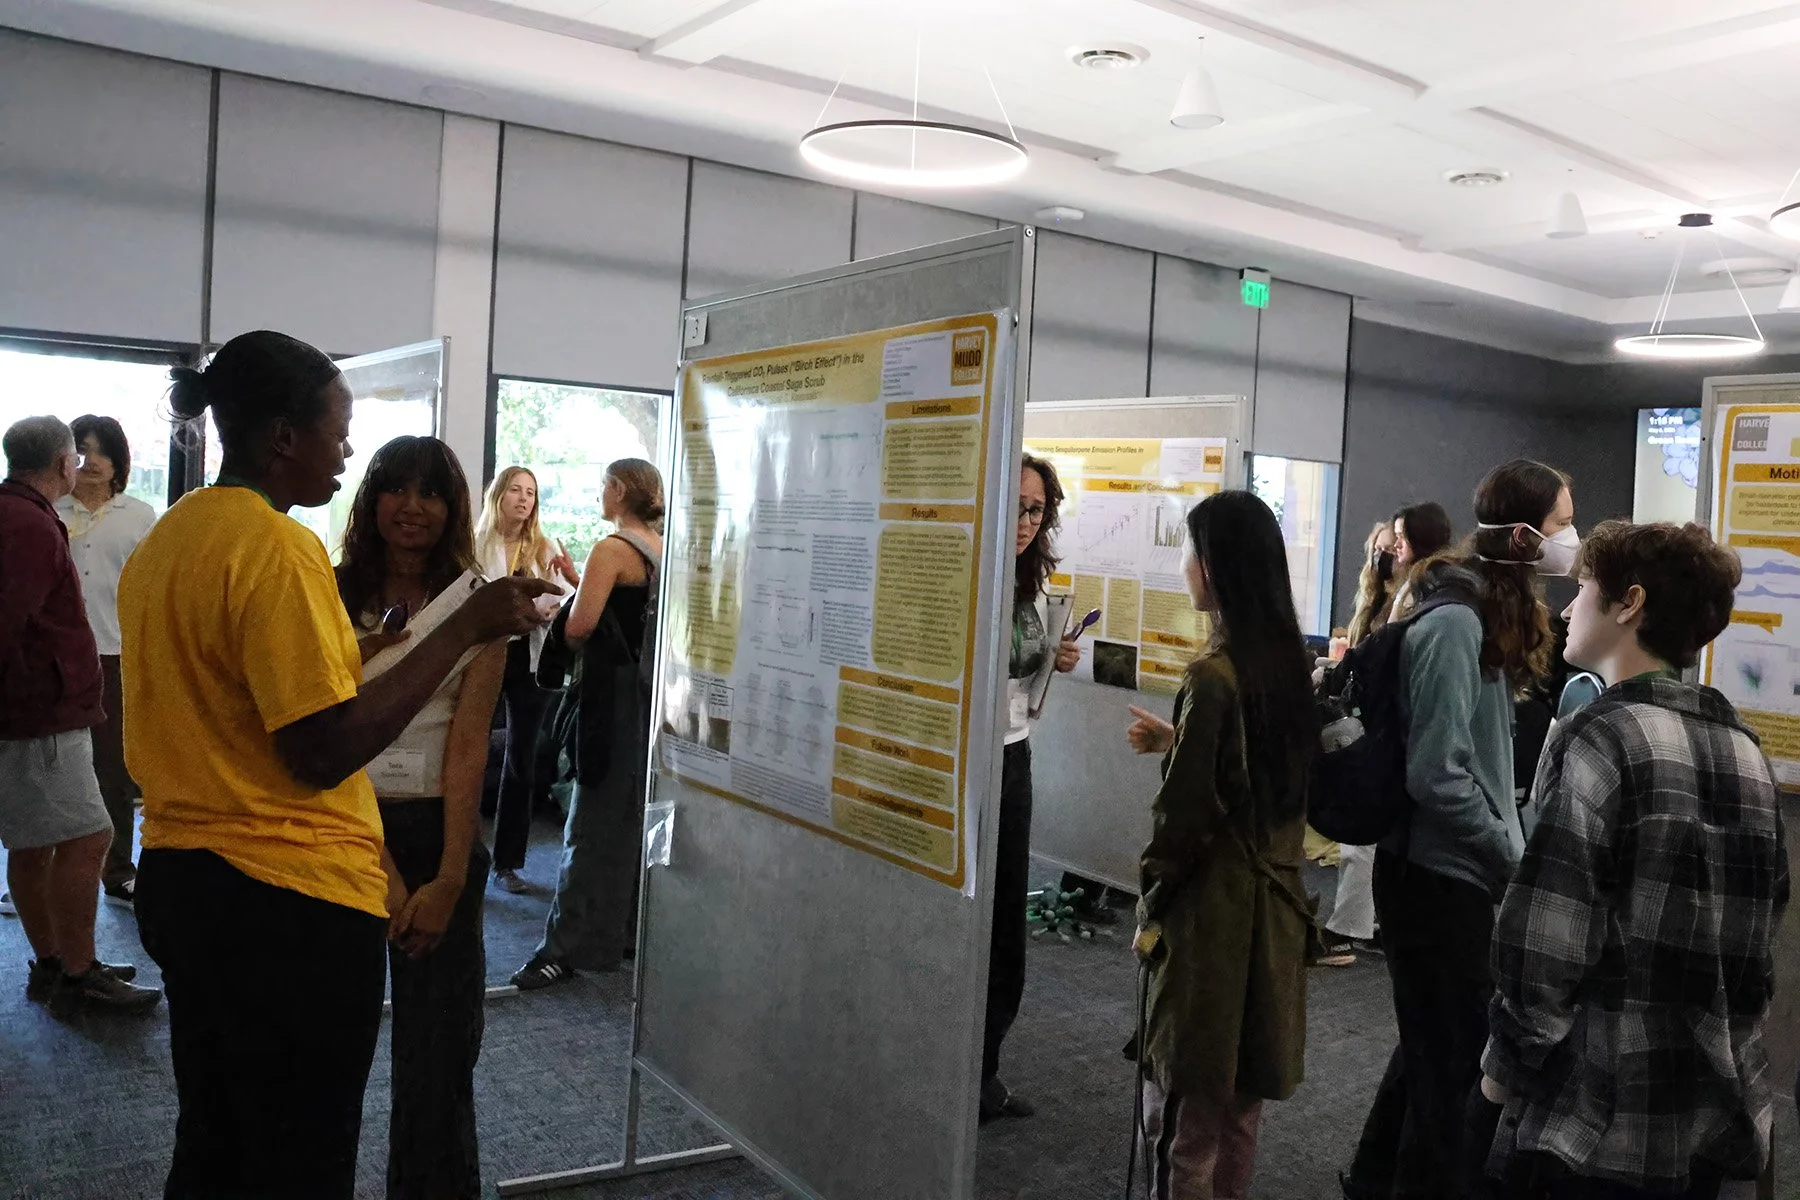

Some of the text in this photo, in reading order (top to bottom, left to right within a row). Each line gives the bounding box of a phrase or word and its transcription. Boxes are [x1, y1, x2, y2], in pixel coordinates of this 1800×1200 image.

[767, 364, 788, 376] Pulses
[852, 352, 865, 364] the
[954, 349, 981, 368] MUDD
[786, 378, 803, 392] Sage
[804, 375, 826, 388] Scrub
[912, 404, 951, 415] Limitations
[1116, 445, 1137, 454] Profiles
[1108, 481, 1132, 491] Results
[912, 507, 937, 518] Results
